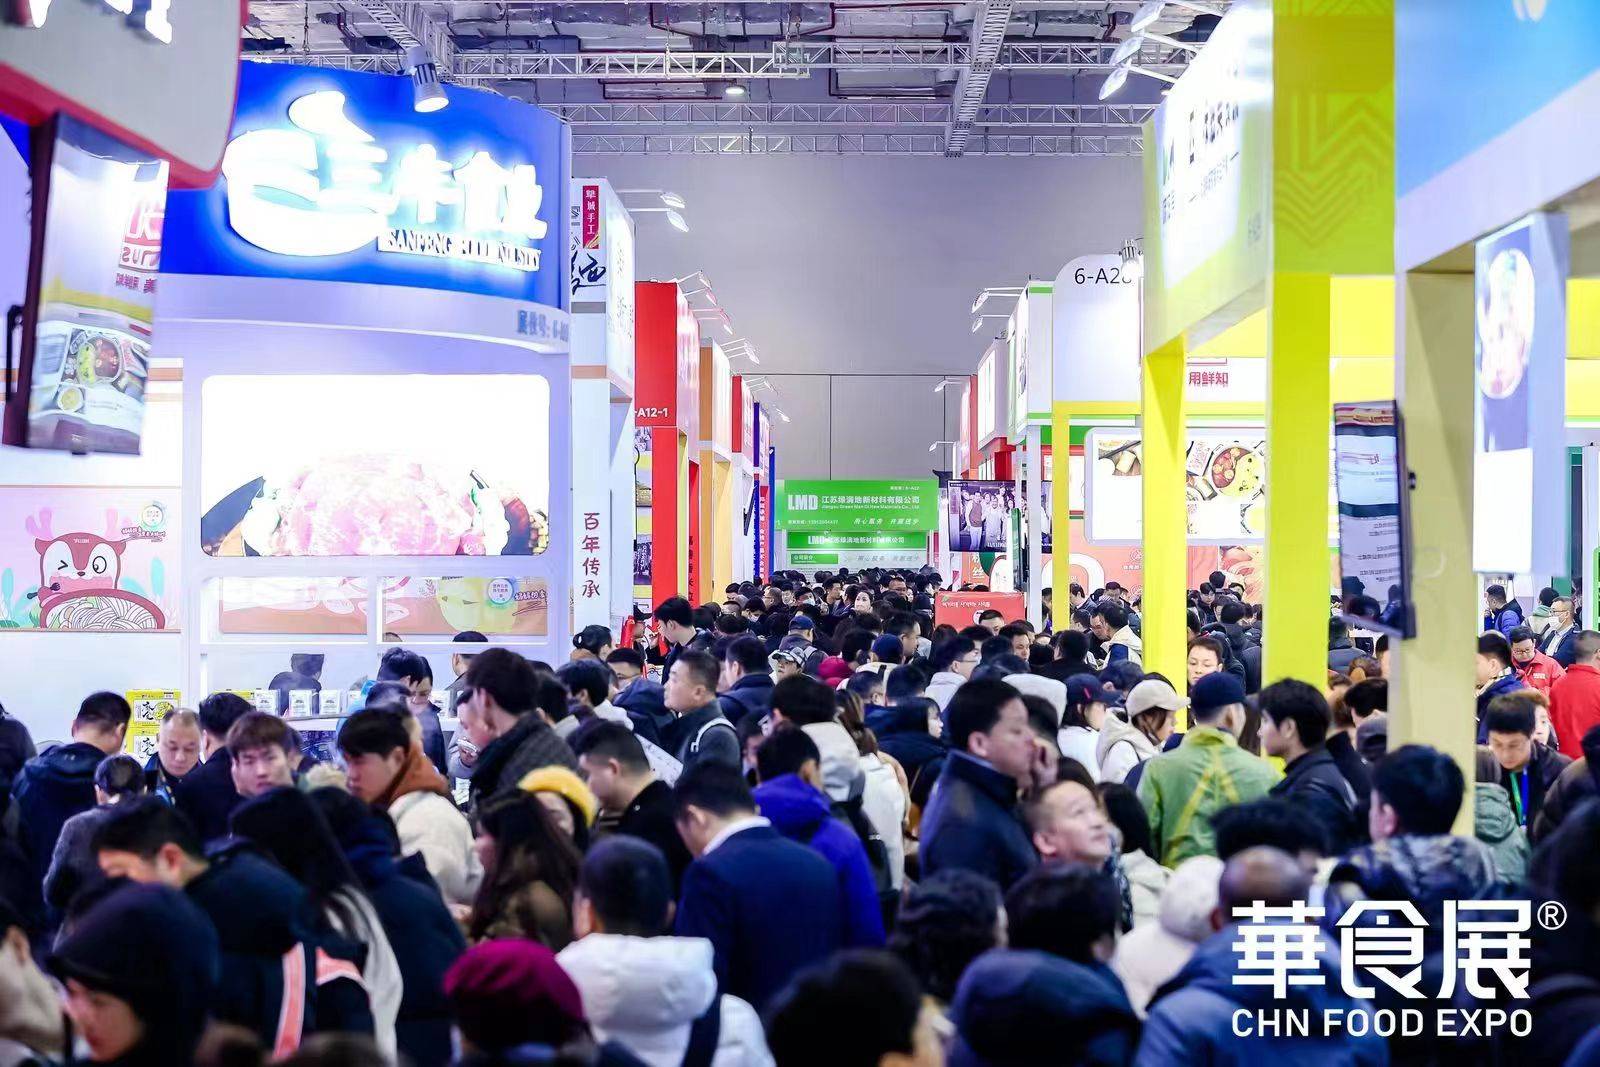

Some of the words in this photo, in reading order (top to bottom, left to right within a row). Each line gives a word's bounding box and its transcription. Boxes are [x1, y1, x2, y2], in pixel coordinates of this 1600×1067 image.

[1188, 371, 1229, 387] 用鲜知
[788, 494, 819, 511] LMD
[581, 512, 600, 599] 百年传承
